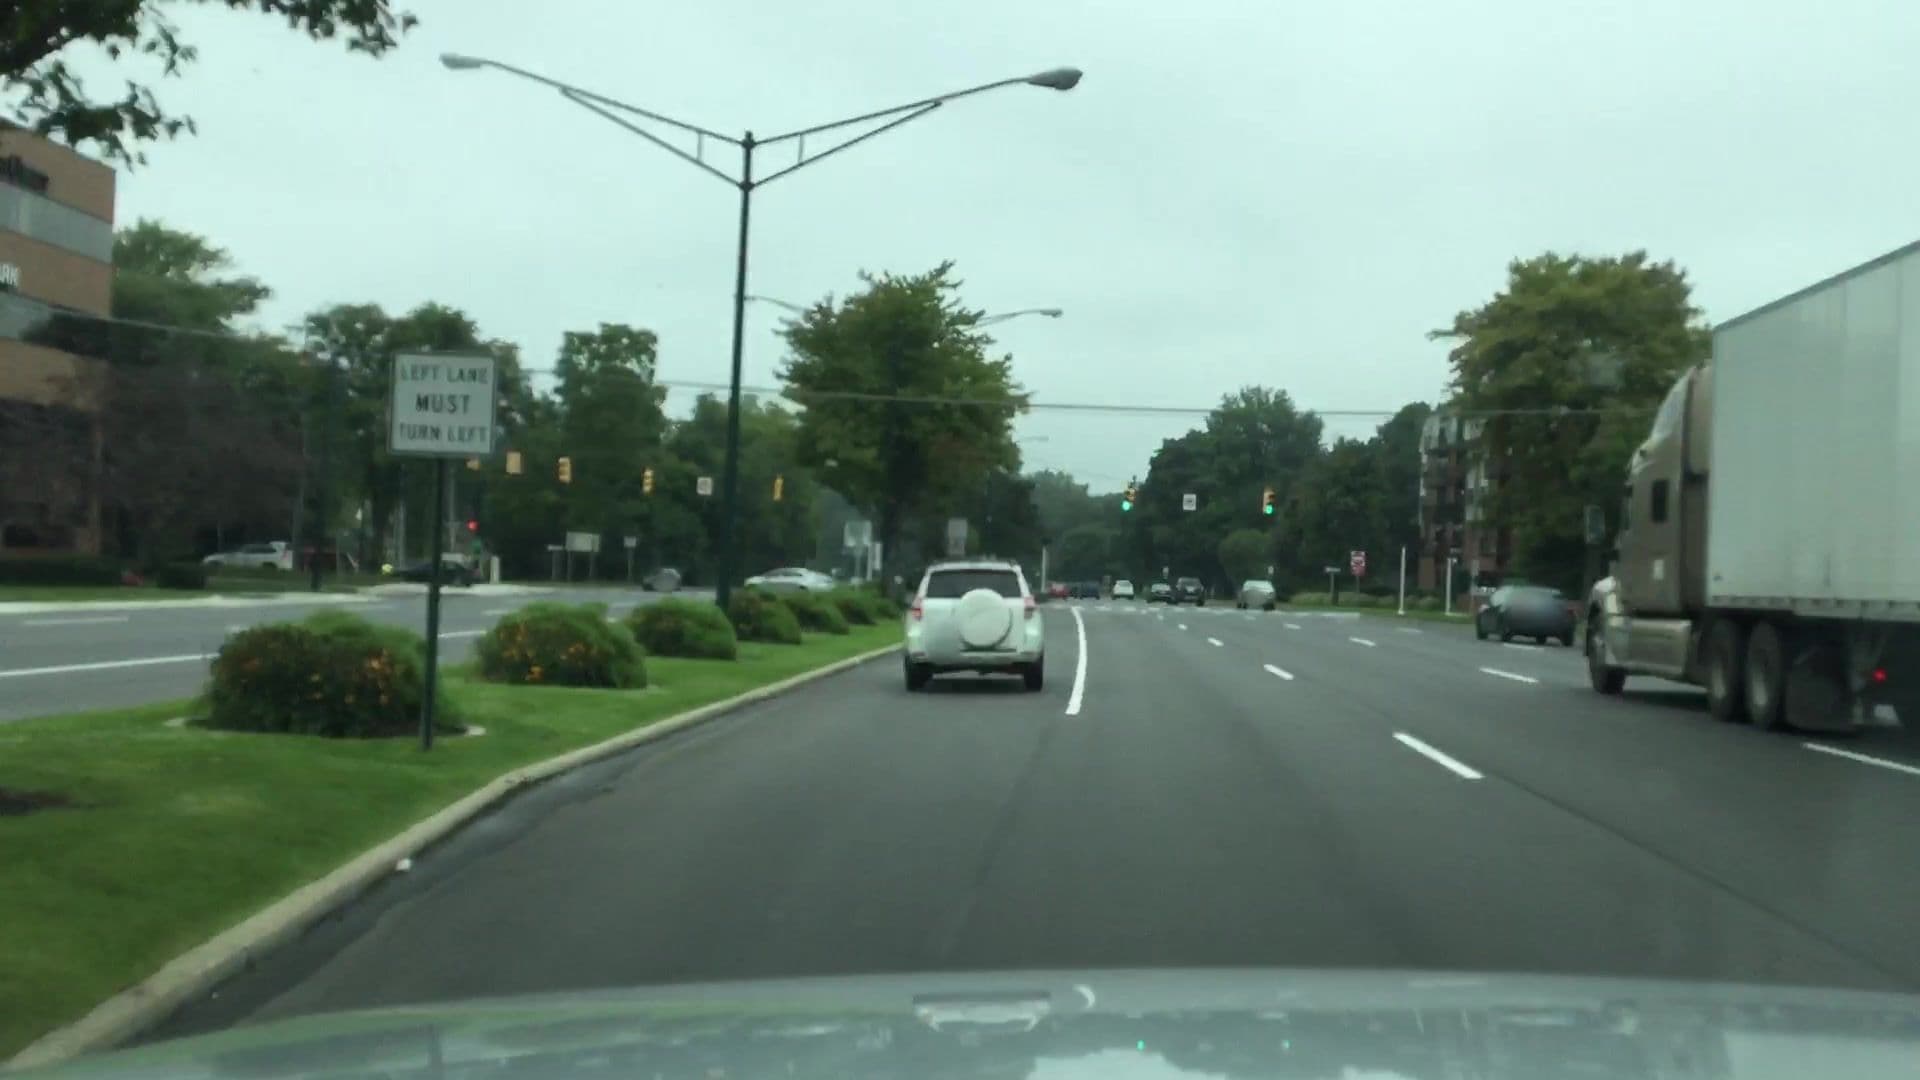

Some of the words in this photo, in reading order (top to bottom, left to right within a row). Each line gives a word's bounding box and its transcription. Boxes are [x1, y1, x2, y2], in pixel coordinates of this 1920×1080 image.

[400, 364, 440, 381] LEFT
[447, 367, 488, 384] LANE
[416, 393, 470, 414] MUST
[400, 422, 440, 440] TURN
[448, 426, 488, 442] LEFT
